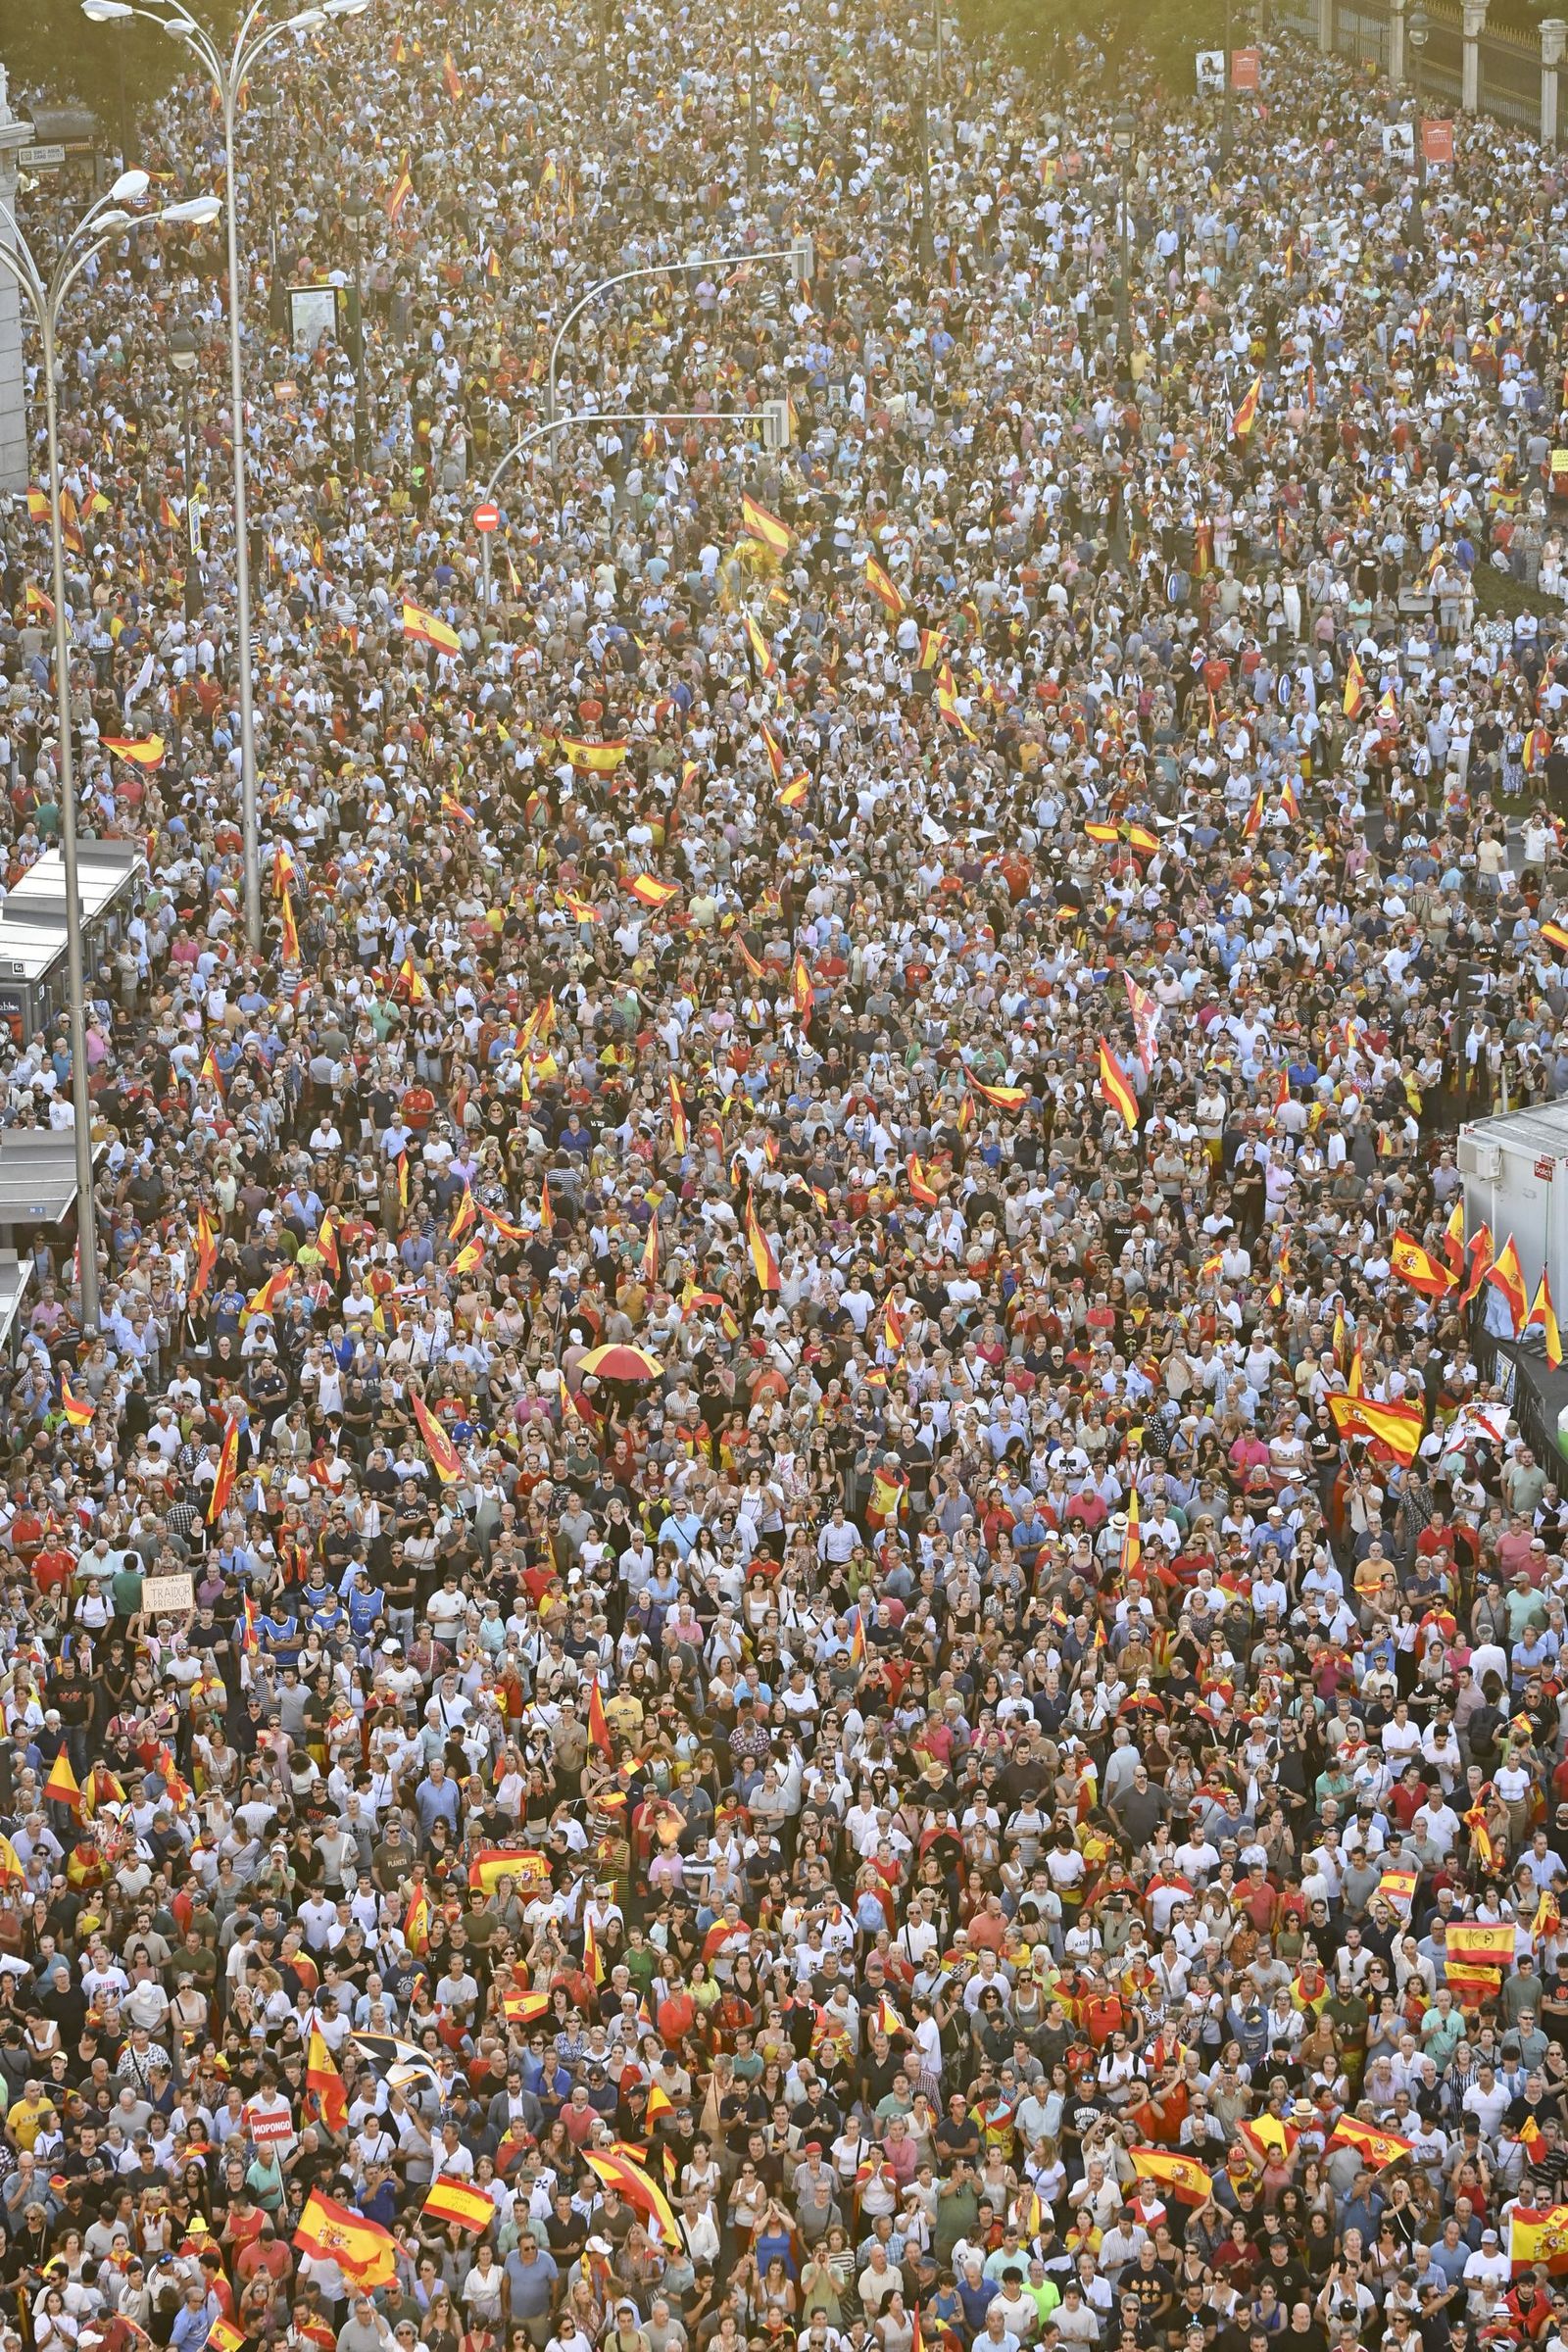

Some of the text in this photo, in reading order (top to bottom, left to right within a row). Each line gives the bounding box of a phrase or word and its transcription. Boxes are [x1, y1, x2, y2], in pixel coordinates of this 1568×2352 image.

[150, 1584, 191, 1599] TRAIDOR
[387, 1858, 408, 1868] PLANETA
[253, 2120, 291, 2134] MOPONGO
